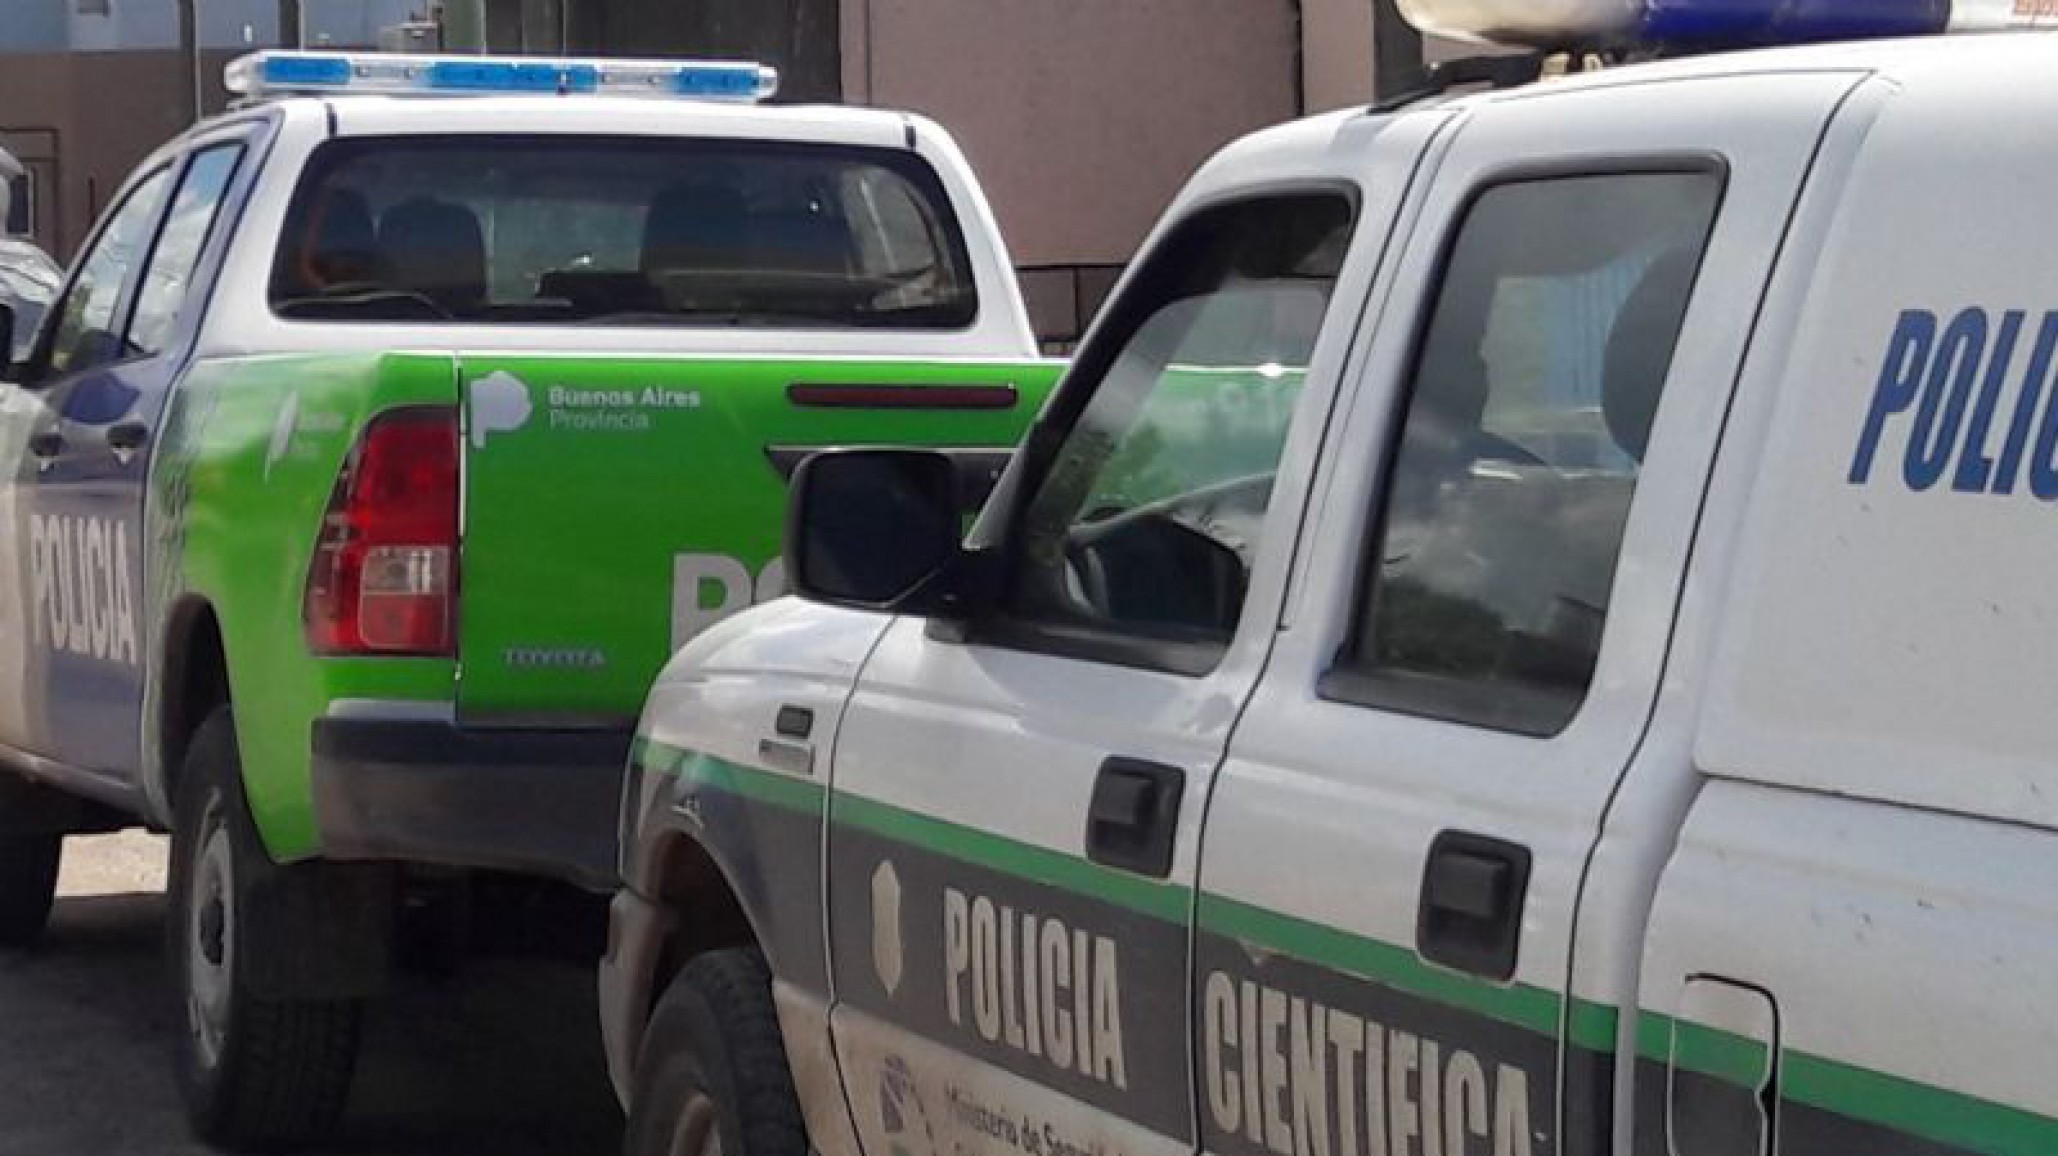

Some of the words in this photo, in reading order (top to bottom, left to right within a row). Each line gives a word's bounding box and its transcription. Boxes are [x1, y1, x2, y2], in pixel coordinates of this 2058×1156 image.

[549, 385, 634, 407] Buenos
[640, 385, 701, 407] Aires
[550, 409, 650, 430] Provincia
[31, 513, 137, 664] POLICIA
[504, 647, 605, 667] TOYOTA
[944, 887, 1127, 1091] POLICIA
[1205, 969, 1531, 1156] CIENTIFICA
